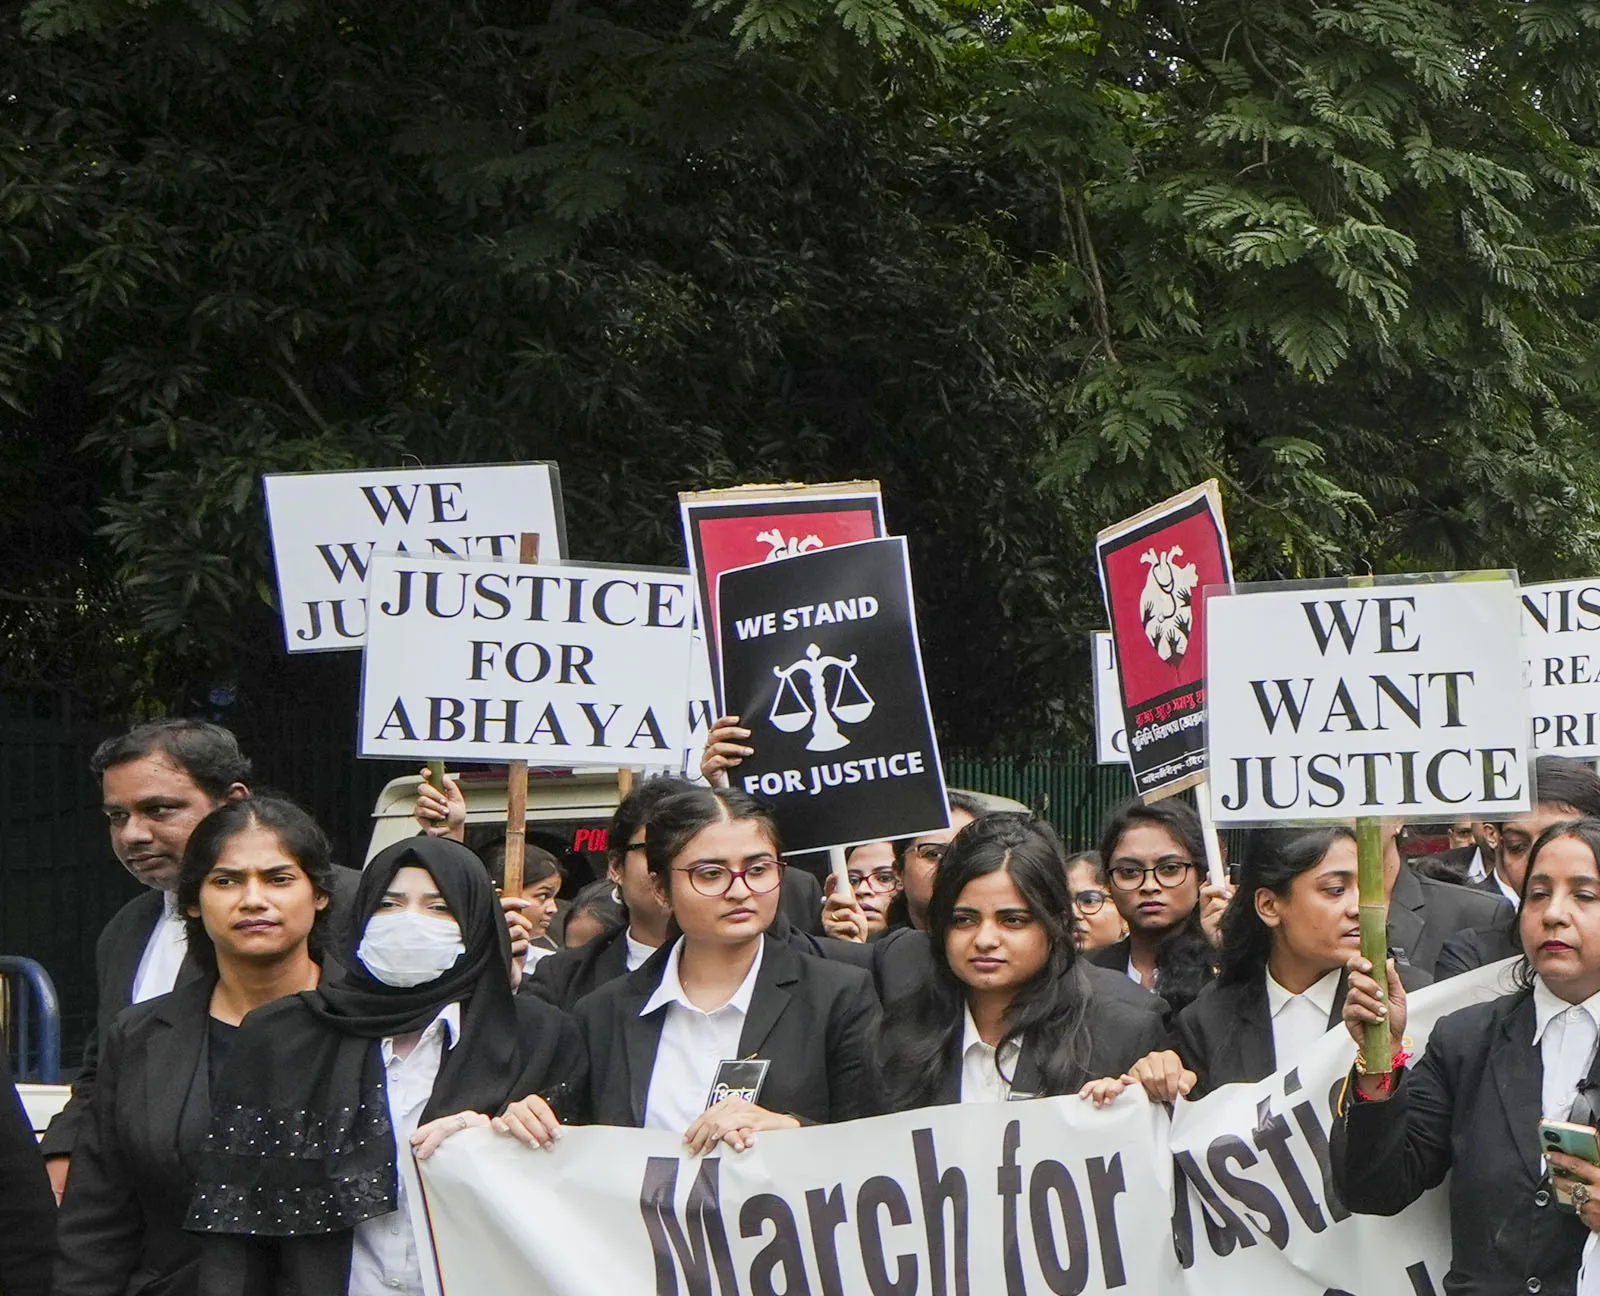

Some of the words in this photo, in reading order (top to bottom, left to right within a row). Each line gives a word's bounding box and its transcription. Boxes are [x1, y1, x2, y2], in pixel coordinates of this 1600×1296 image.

[360, 482, 469, 526] WE
[380, 570, 686, 629] JUSTICE
[735, 613, 777, 641] WE
[783, 596, 879, 632] STAND
[1300, 597, 1421, 656] WE
[466, 640, 597, 685] FOR
[373, 695, 672, 750] ABHAYA
[1249, 671, 1475, 735] WANT
[743, 771, 806, 796] FOR
[808, 751, 925, 795] JUSTICE
[1221, 748, 1521, 811] JUSTICE
